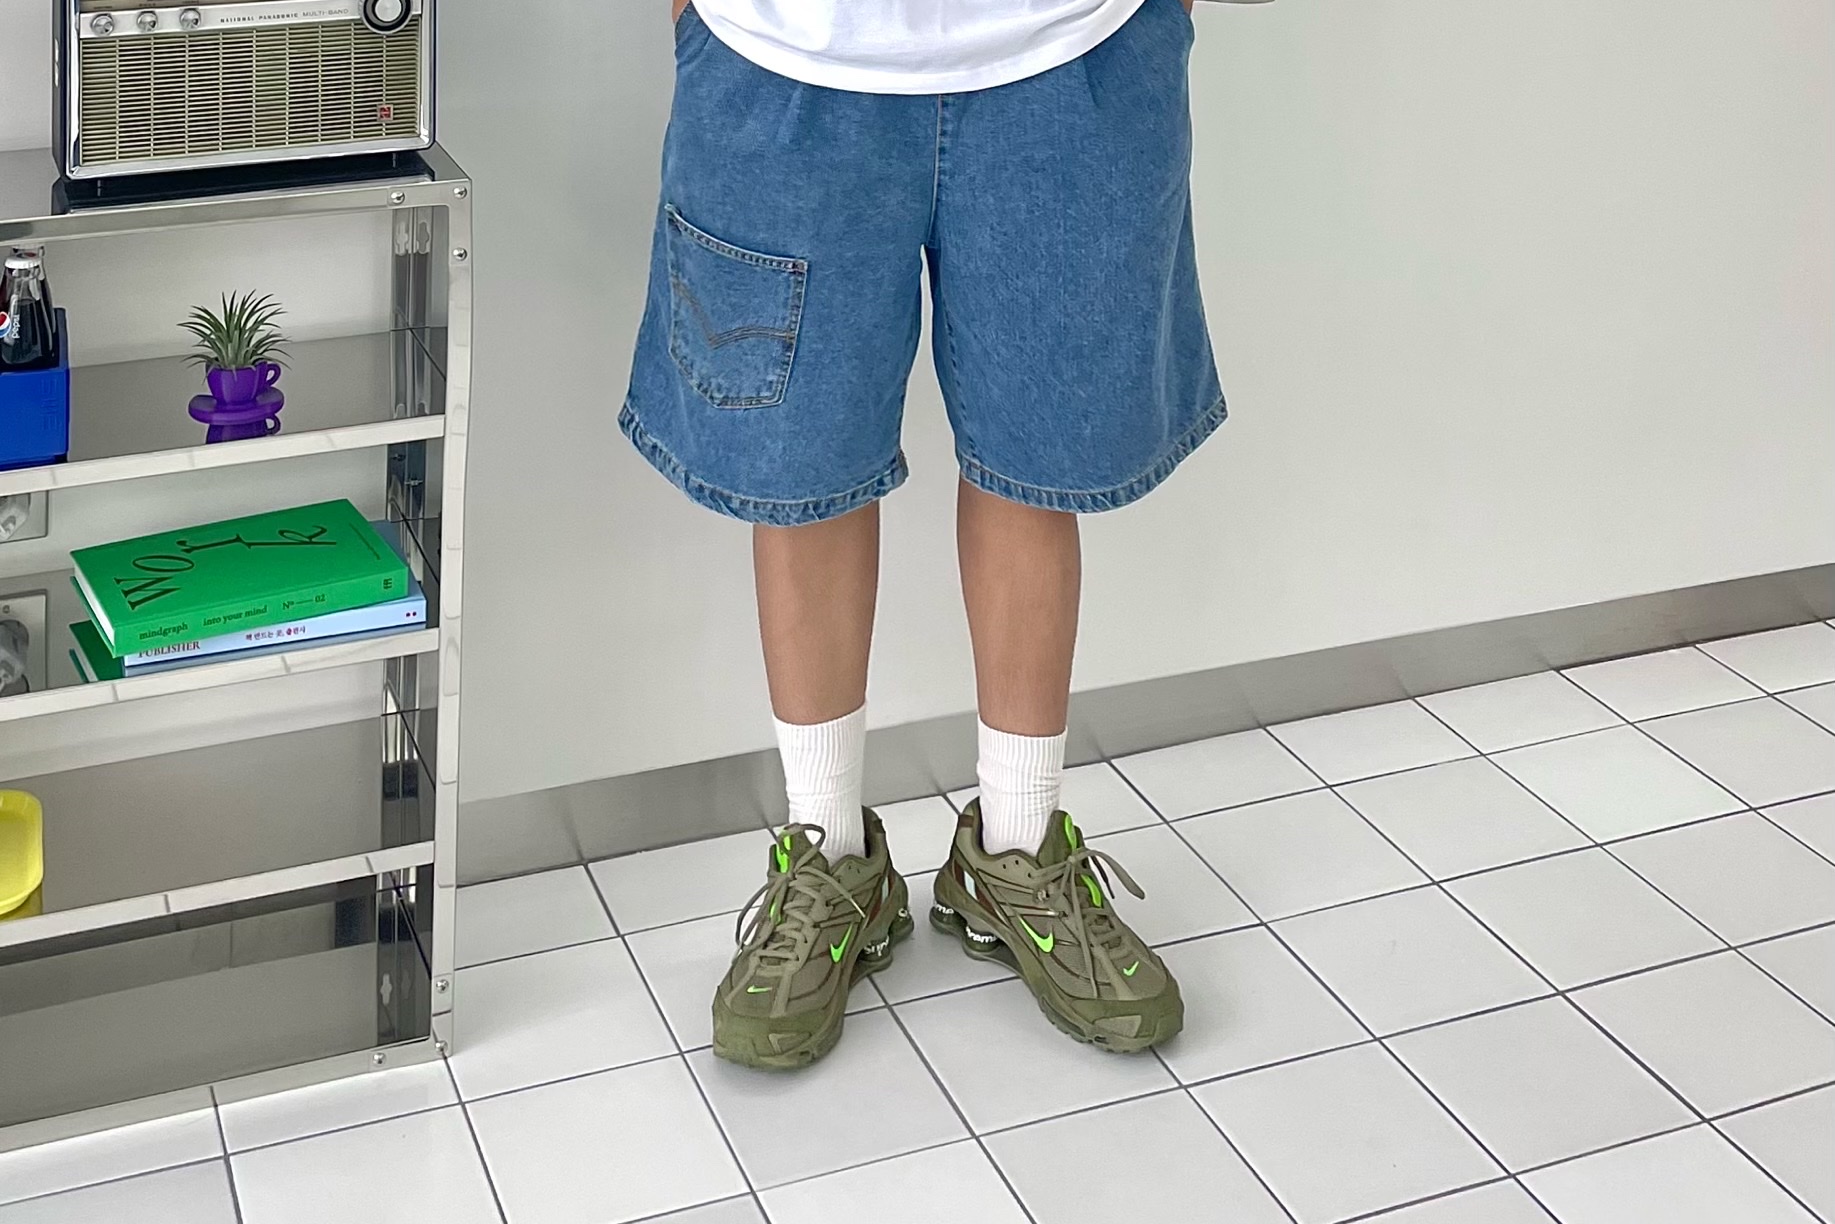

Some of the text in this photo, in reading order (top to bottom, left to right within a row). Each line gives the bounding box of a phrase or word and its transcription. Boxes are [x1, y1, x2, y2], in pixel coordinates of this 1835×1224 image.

[258, 12, 299, 20] PANASONIC
[139, 621, 189, 640] mindgraph
[203, 615, 222, 627] into
[223, 612, 244, 625] your
[244, 604, 268, 618] mind
[315, 594, 326, 604] 02
[138, 640, 200, 658] PUBLISHER
